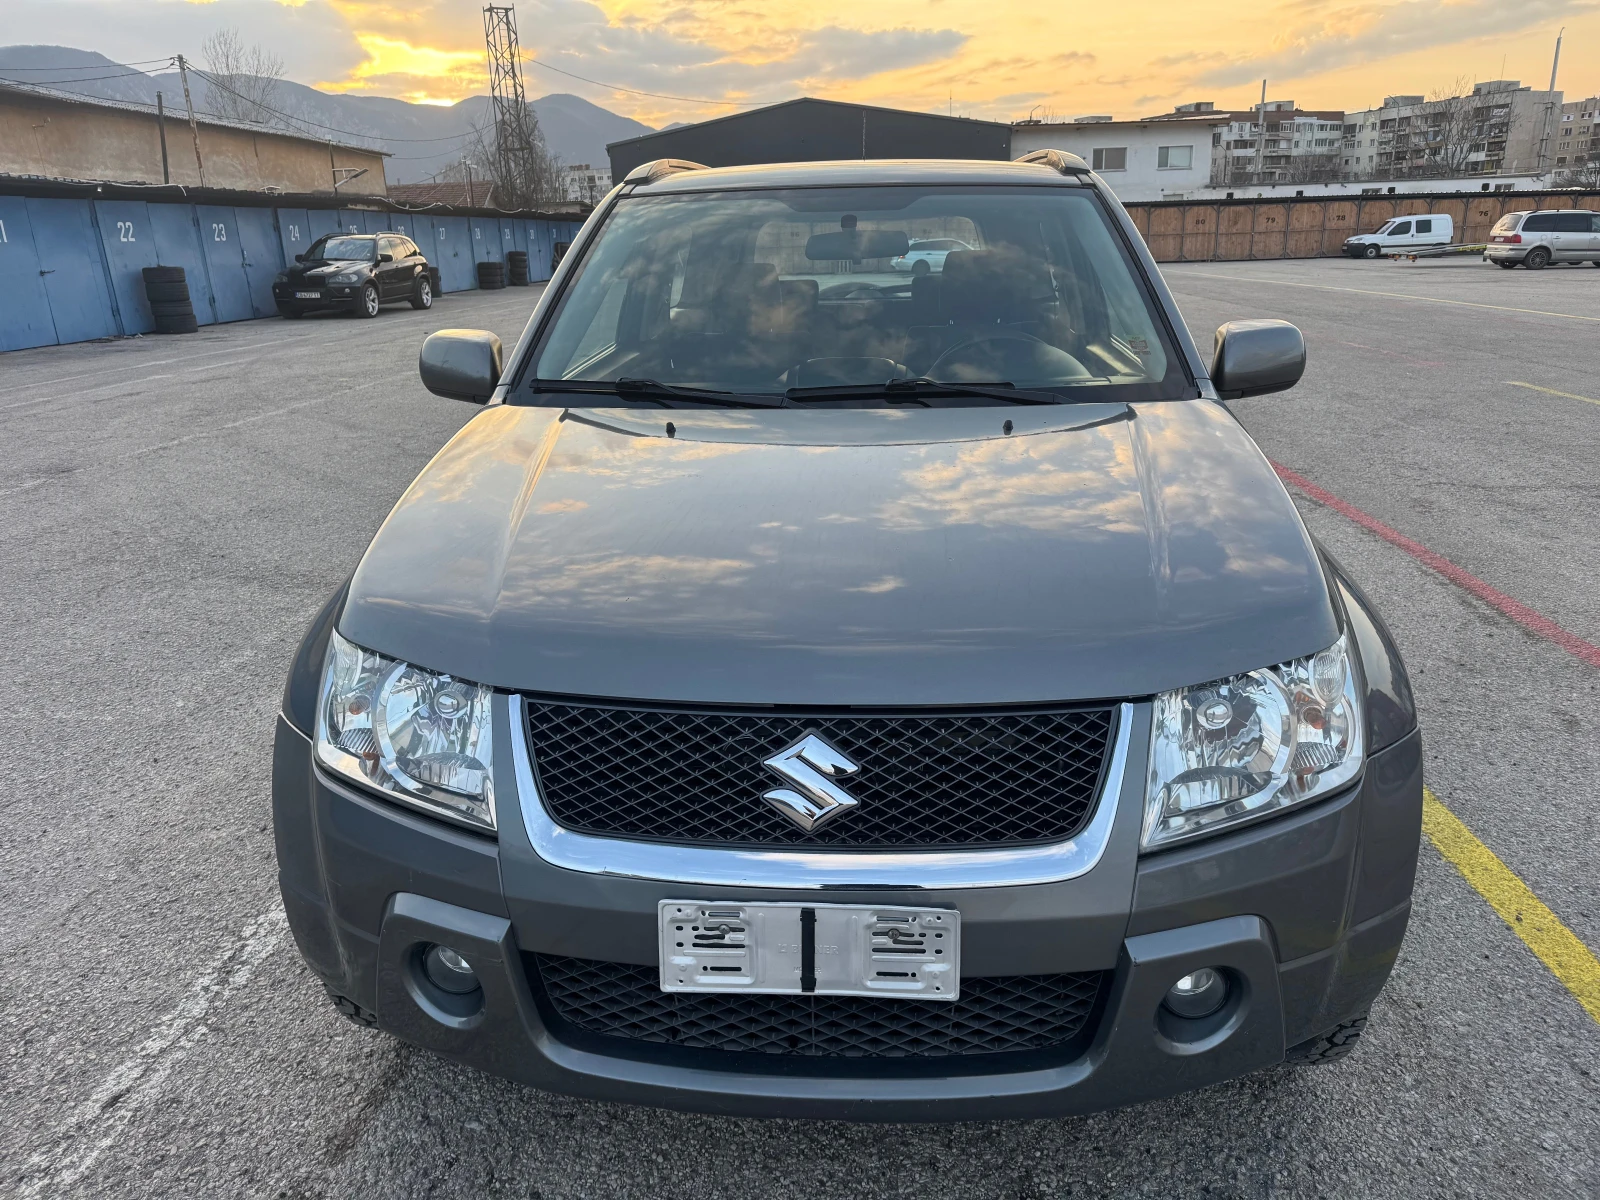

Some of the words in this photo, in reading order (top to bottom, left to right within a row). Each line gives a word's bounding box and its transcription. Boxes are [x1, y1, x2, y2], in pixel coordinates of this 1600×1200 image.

[117, 222, 136, 242] 22
[212, 223, 227, 241] 23
[289, 225, 300, 241] 24
